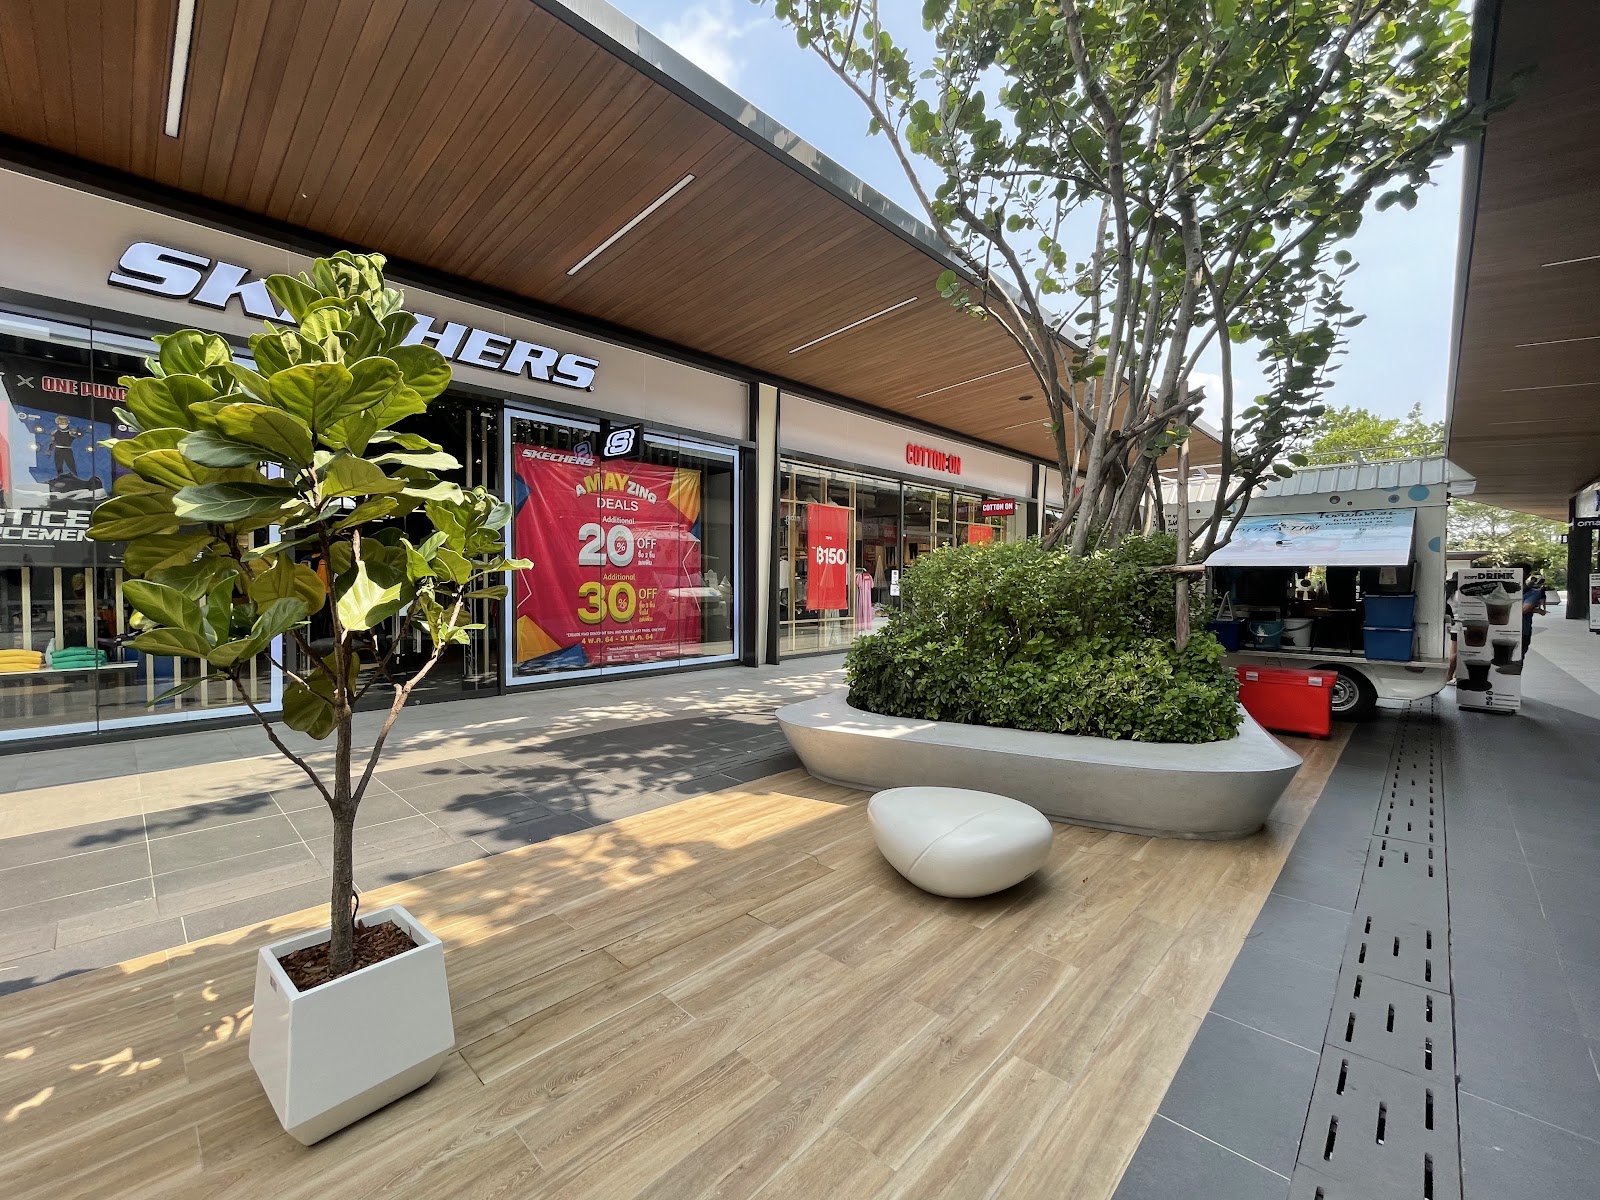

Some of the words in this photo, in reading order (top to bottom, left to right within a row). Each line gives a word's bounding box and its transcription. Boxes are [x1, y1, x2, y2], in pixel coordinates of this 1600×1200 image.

[109, 241, 599, 391] SKHERS
[41, 376, 78, 395] ONE
[81, 382, 128, 402] PUNC
[522, 449, 595, 466] SKECHERS
[575, 471, 657, 504] AMAYZING
[597, 498, 639, 512] DEALS
[982, 504, 1004, 512] COTTON
[1004, 502, 1013, 510] ON
[0, 509, 91, 528] TICE
[602, 516, 635, 524] Additional
[578, 523, 634, 567] 20
[637, 538, 657, 549] OFF
[1477, 572, 1515, 580] DRINK
[578, 581, 636, 624] 30
[638, 588, 657, 599] OFF
